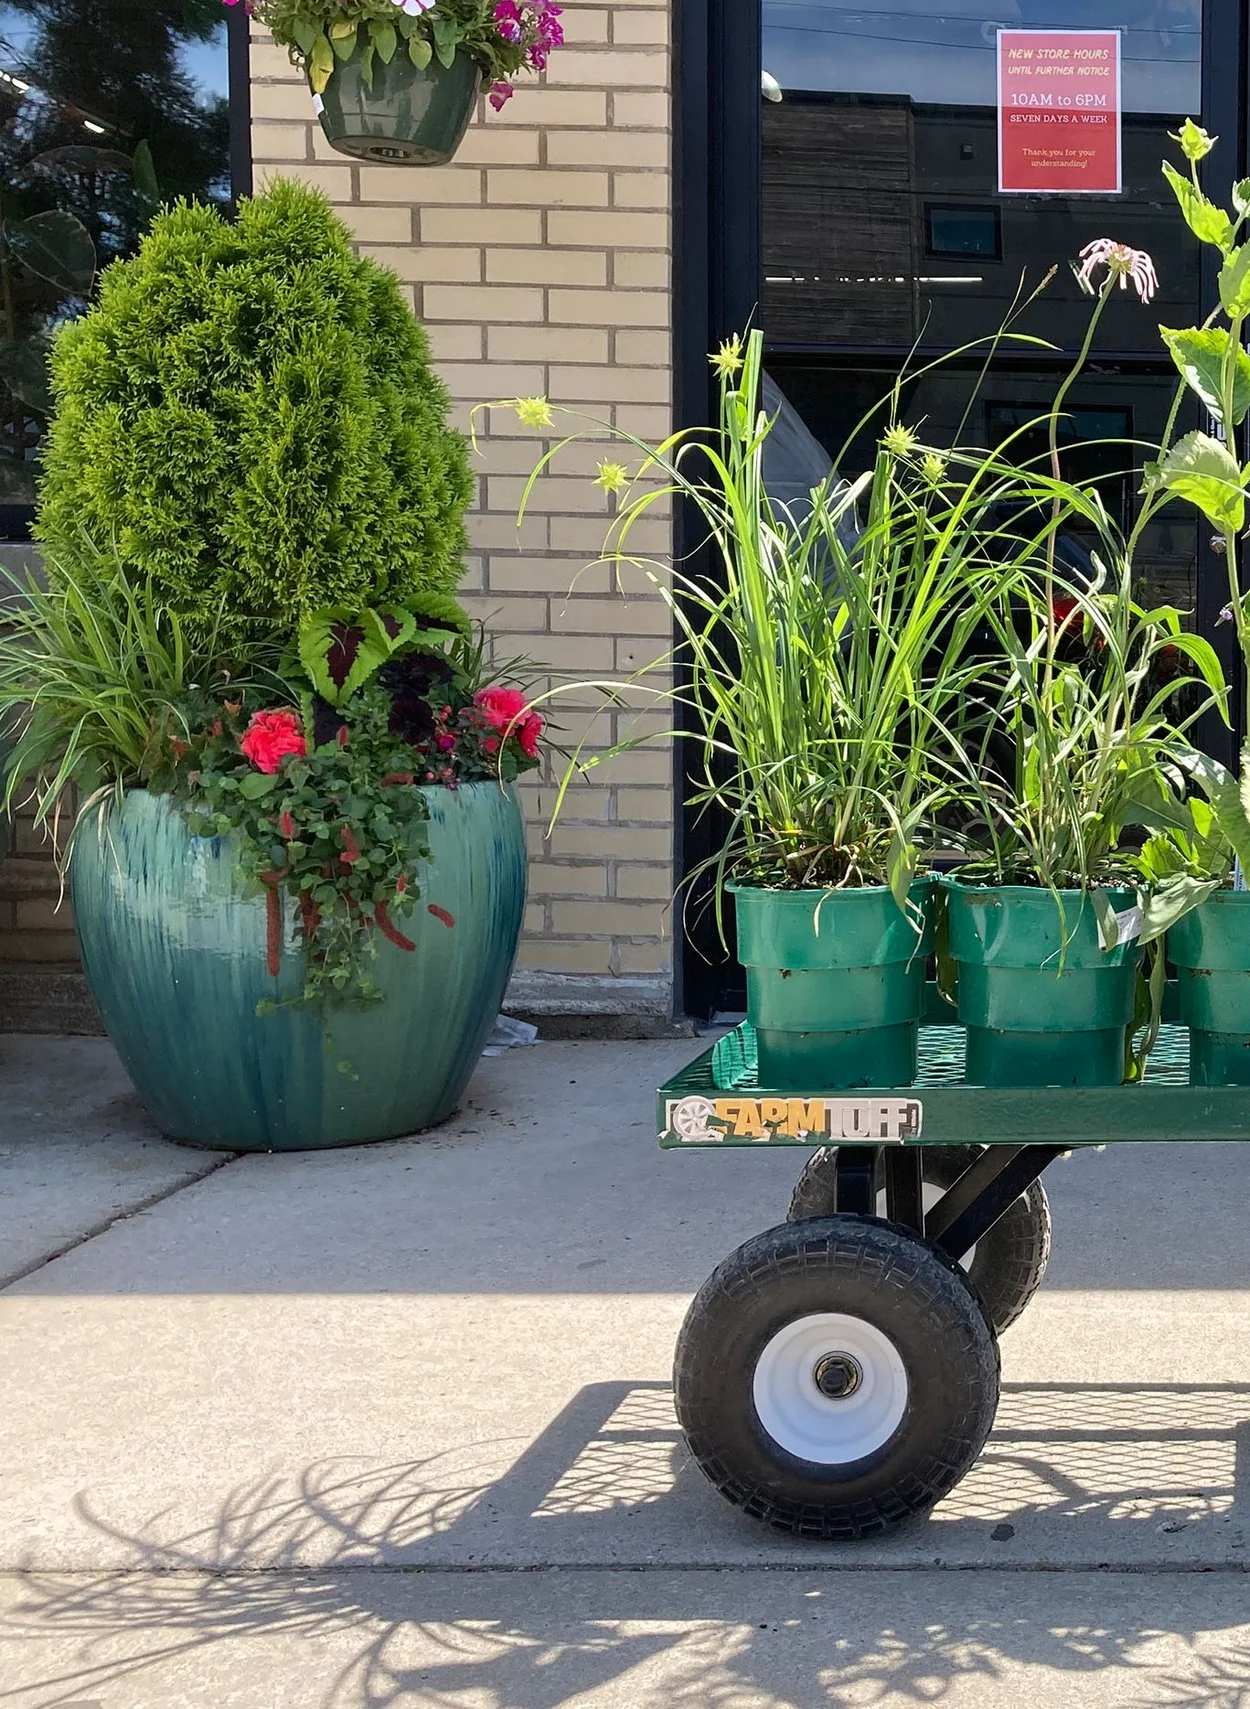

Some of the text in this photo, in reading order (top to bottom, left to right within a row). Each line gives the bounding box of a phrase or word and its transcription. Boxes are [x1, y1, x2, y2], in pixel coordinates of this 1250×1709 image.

[1008, 49, 1109, 60] NEW STORE HOURS
[1008, 66, 1110, 76] UNTIL FURTHER NOTICE
[1011, 93, 1107, 107] 10AM to 6PM
[1010, 114, 1108, 124] SEVEN DAYS A WEEK
[1022, 148, 1096, 158] Thank you for your
[1031, 159, 1088, 169] understanding!
